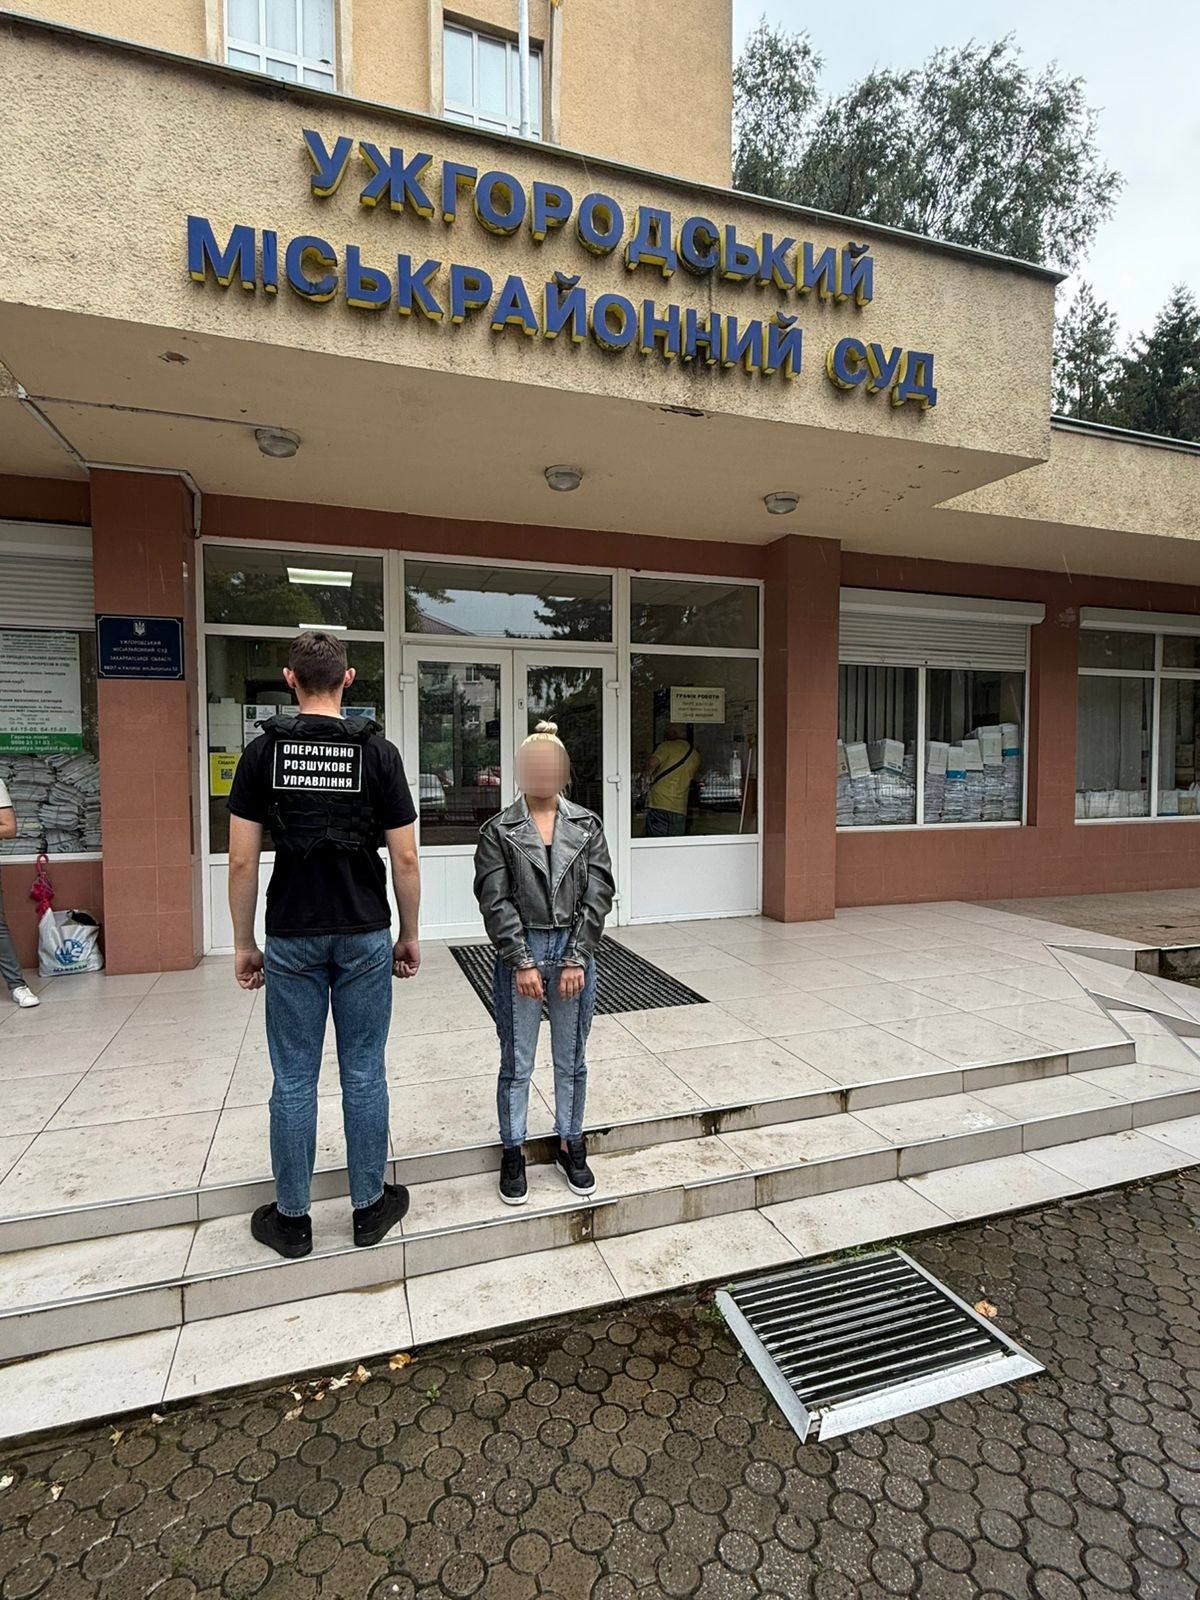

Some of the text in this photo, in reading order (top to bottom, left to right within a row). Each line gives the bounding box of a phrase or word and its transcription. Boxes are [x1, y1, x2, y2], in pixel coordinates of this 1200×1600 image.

[303, 129, 874, 306] УЖГОРОДСЬКИЙ
[187, 215, 938, 410] МІСЬКРАЙОННИЙ СУД
[283, 743, 355, 758] ОПЕРАТИВНО
[283, 759, 353, 773] РОЗШУКОВЕ
[282, 774, 353, 788] УПРАВЛІННЯ
